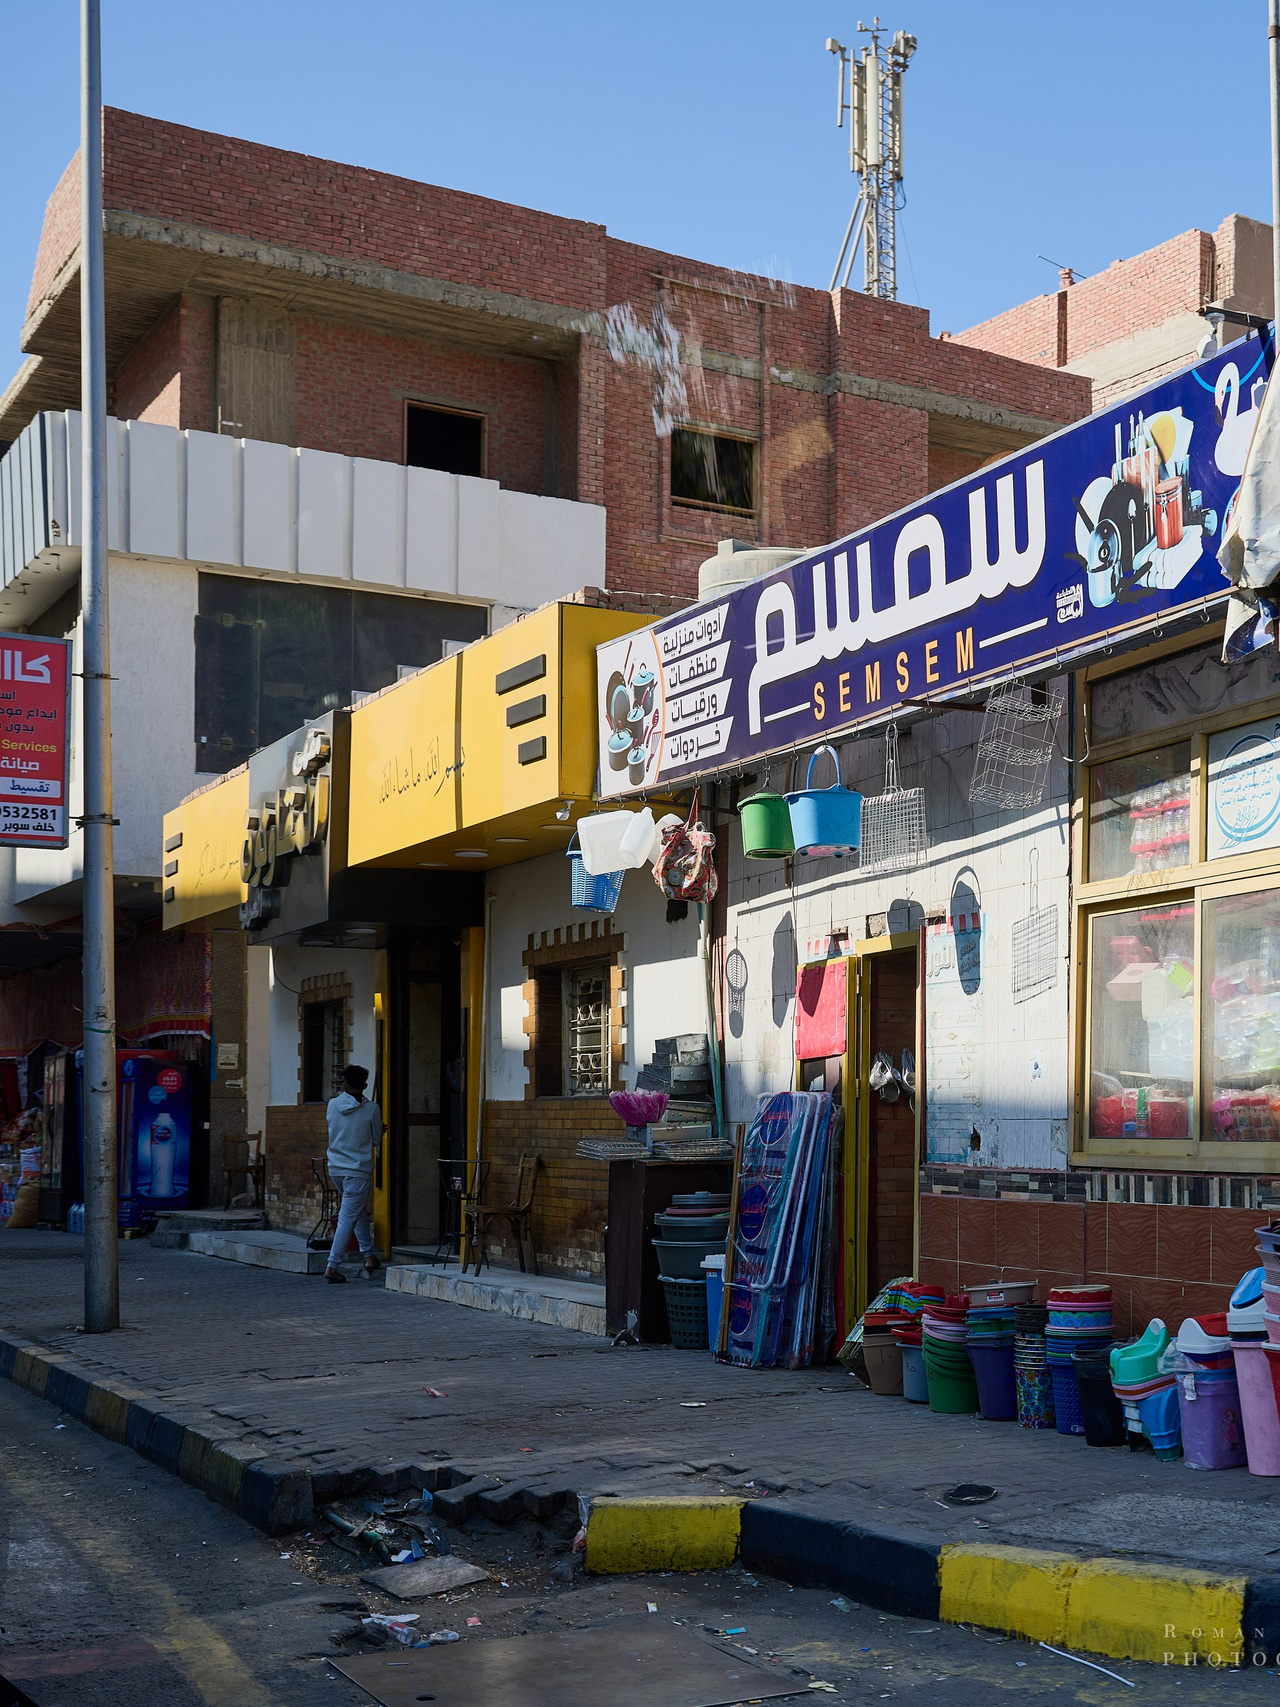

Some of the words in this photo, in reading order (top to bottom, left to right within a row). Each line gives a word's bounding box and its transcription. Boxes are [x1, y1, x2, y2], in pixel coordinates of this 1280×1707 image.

[748, 458, 1046, 736] سمسم
[695, 605, 722, 642] أدوات
[663, 628, 695, 658] منزلية
[669, 654, 718, 689] منظفات
[813, 626, 975, 721] SEMSEM
[0, 706, 23, 719] فود
[26, 707, 57, 720] ايداع
[671, 691, 718, 723] ورقيات
[5, 721, 34, 734] بدون
[1, 738, 58, 753] Services
[670, 724, 721, 761] خردوات
[0, 756, 40, 773] صيانة
[9, 779, 51, 795] تقسيط
[2, 822, 30, 833] سوبر
[32, 821, 56, 832] خلف
